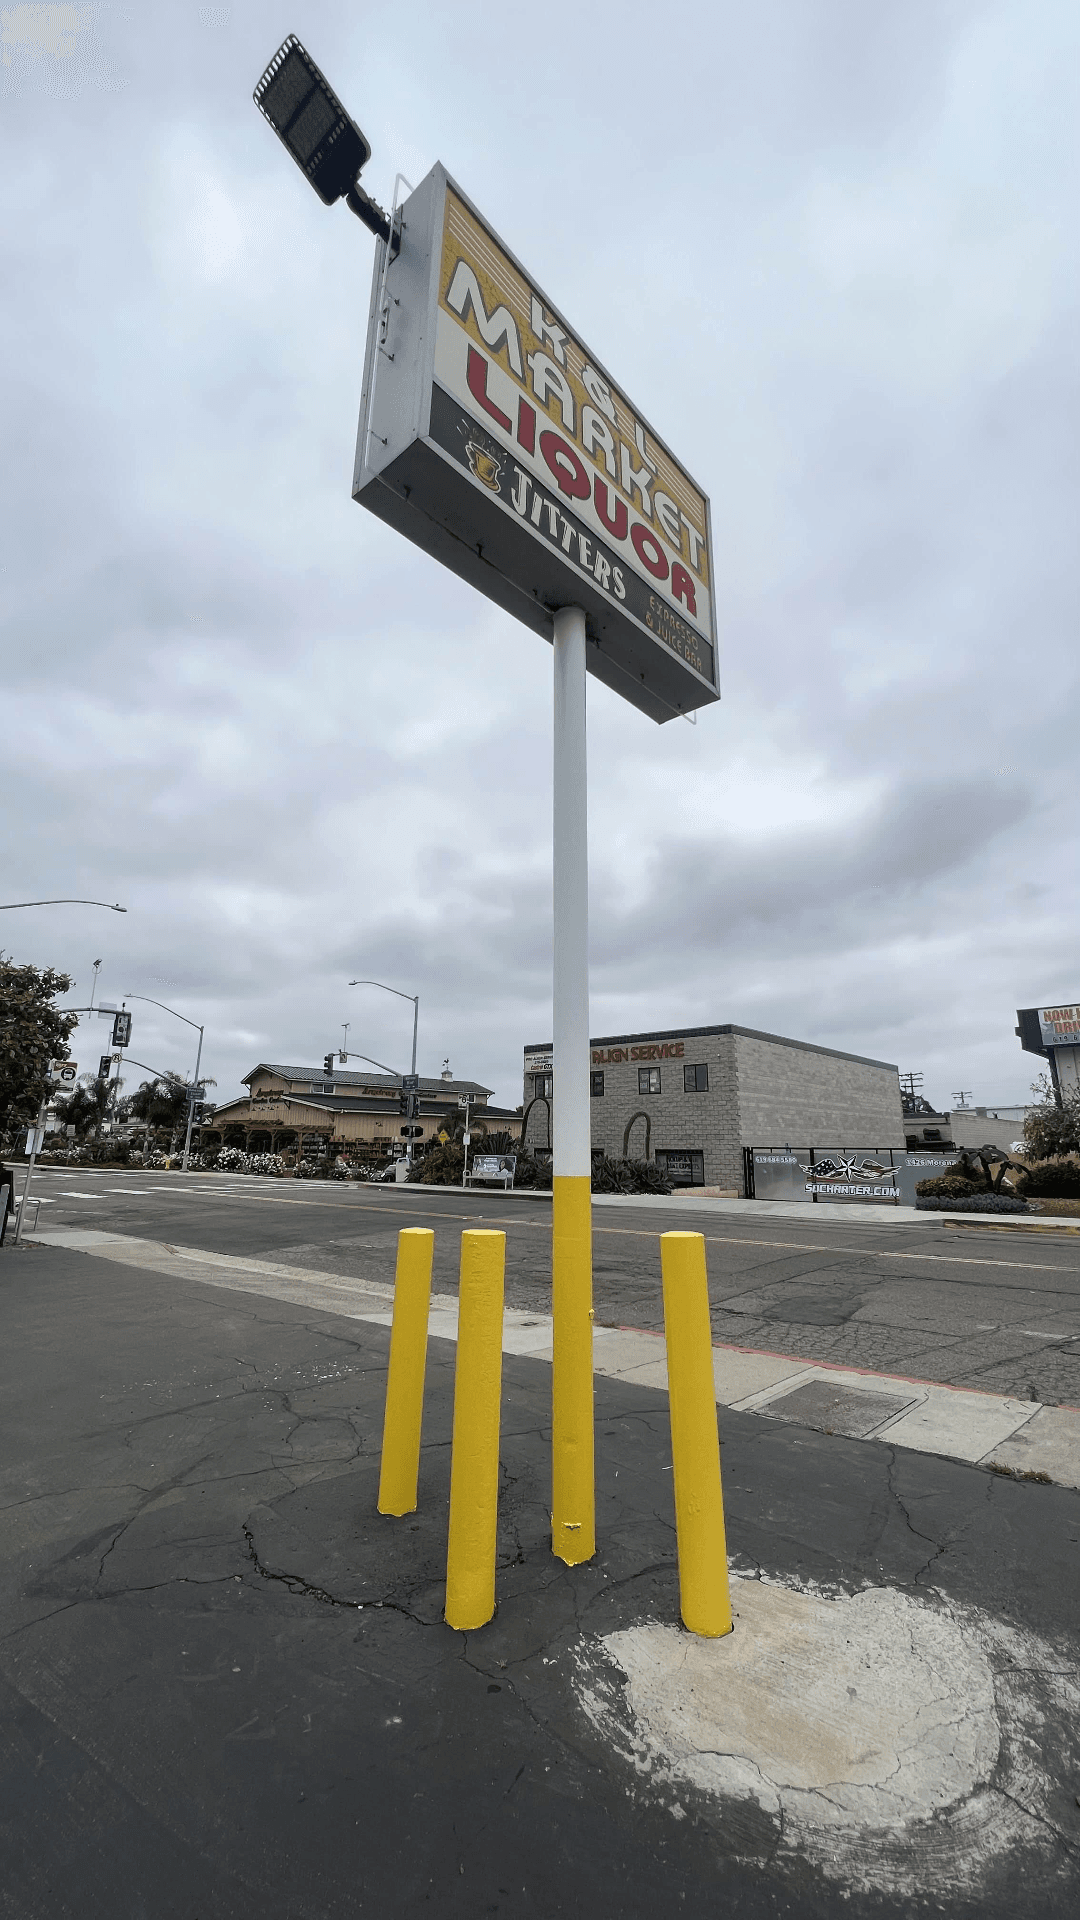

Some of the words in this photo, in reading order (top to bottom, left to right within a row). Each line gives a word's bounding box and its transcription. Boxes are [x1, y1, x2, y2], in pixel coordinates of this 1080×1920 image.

[530, 293, 569, 368] K
[580, 363, 621, 430] &
[634, 418, 658, 475] L
[446, 256, 705, 577] MARKET
[466, 342, 697, 619] LIQUOR
[510, 465, 627, 600] JITTERS
[657, 621, 682, 654] JUICE
[1043, 1009, 1073, 1022] NOW
[1054, 1021, 1080, 1034] DRI
[592, 1048, 628, 1065] ALIGN
[631, 1042, 685, 1061] SERVICE
[755, 1156, 767, 1164] 619
